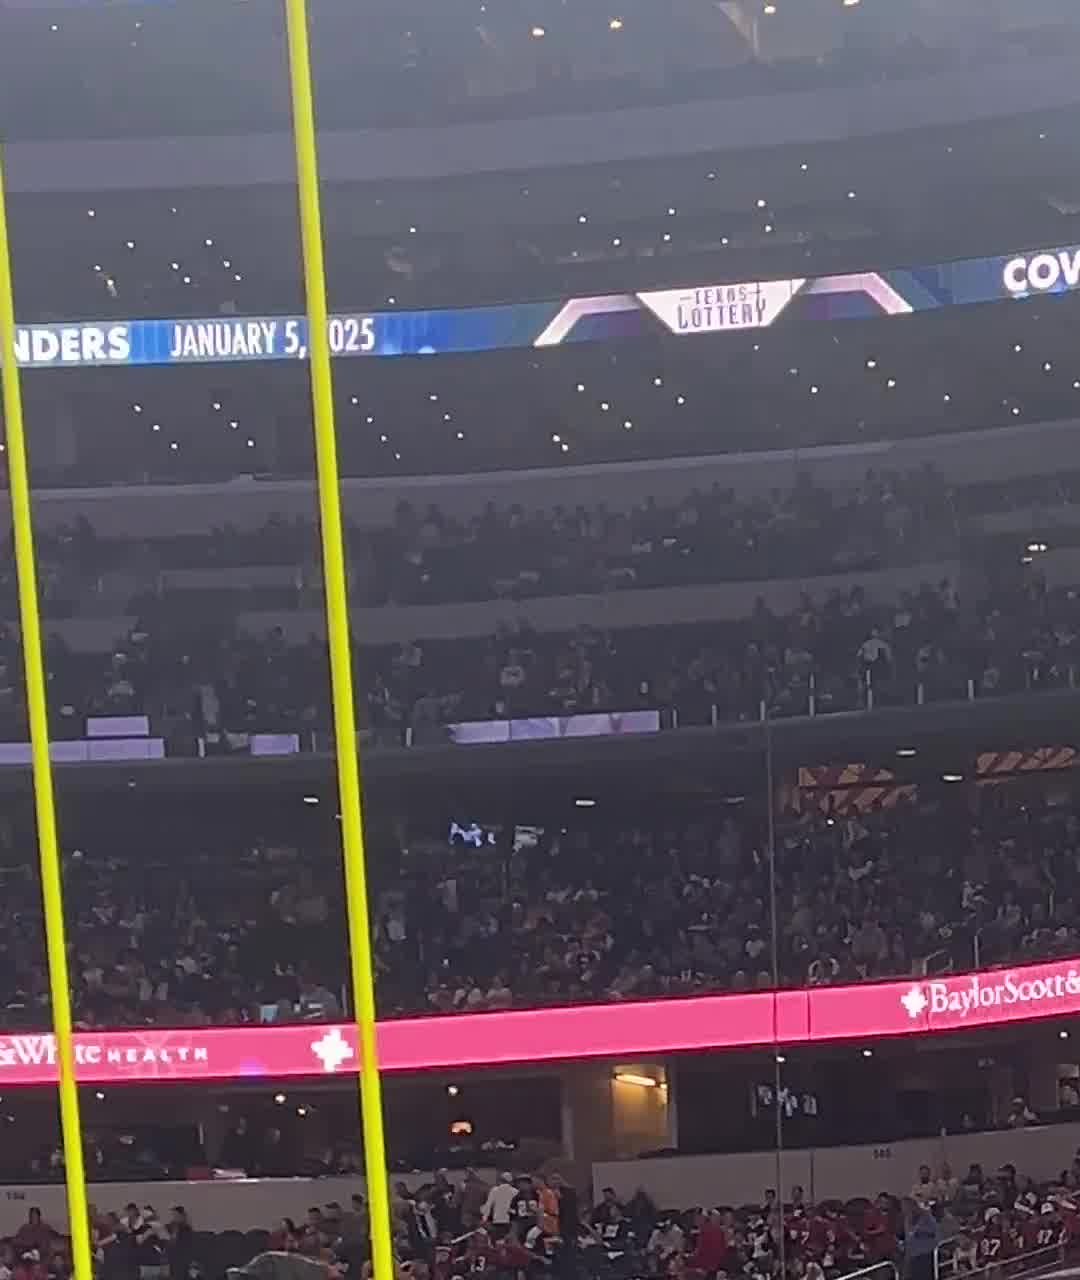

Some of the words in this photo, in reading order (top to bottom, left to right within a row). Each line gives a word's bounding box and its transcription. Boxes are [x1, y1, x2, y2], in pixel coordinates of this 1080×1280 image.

[677, 298, 766, 329] LOTTERY
[170, 322, 277, 357] JANUARY
[284, 320, 306, 359] 5,
[328, 317, 375, 353] 025
[107, 1047, 208, 1063] HEALTH
